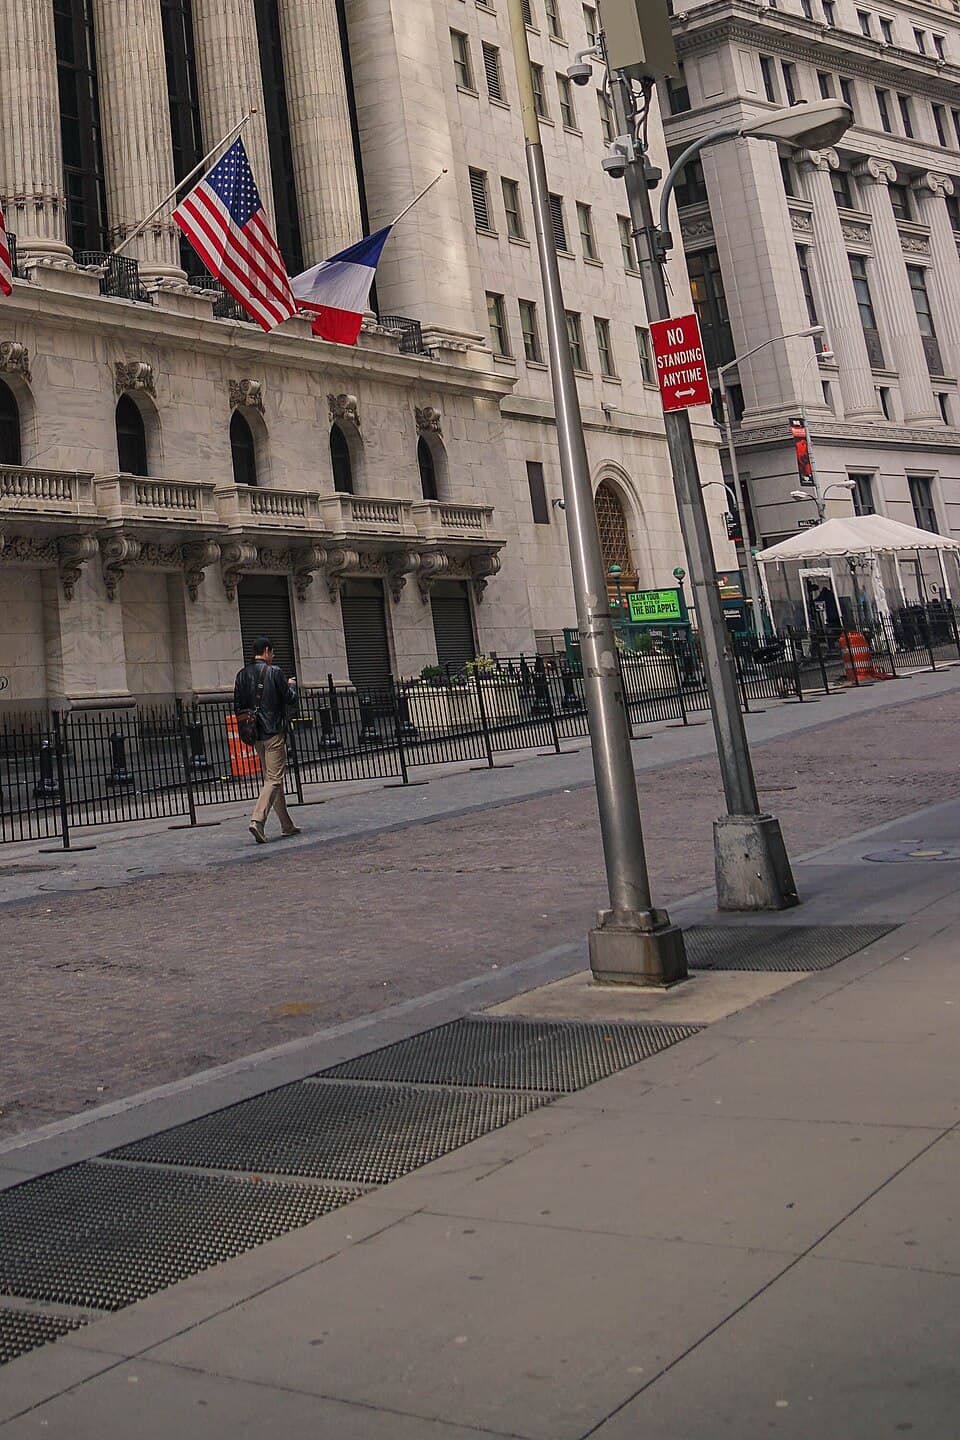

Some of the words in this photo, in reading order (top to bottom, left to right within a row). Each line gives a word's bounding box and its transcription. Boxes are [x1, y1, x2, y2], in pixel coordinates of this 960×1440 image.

[666, 327, 684, 347] NO
[657, 348, 702, 369] STANDING
[663, 367, 703, 387] ANYTIME
[632, 605, 644, 615] THE
[645, 604, 656, 614] BIG
